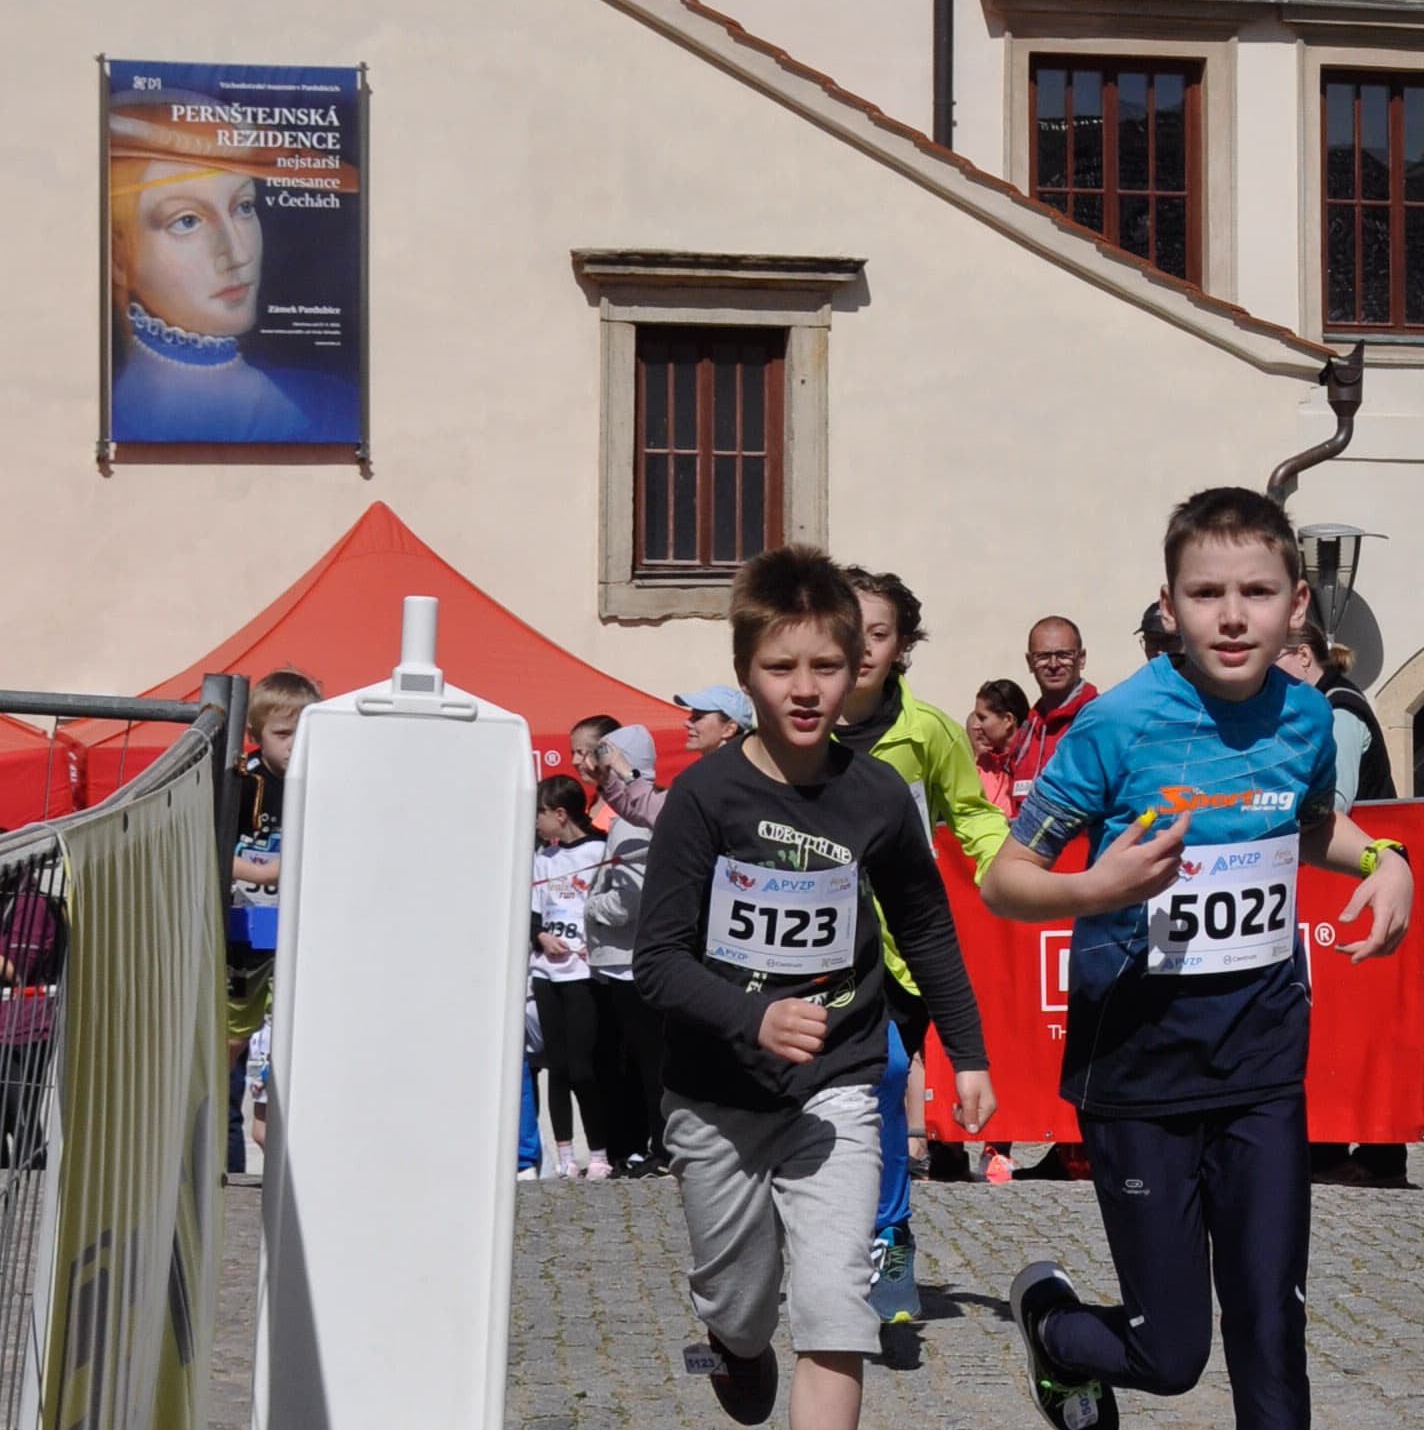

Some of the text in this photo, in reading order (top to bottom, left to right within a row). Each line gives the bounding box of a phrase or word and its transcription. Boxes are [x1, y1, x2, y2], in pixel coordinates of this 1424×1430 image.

[172, 103, 339, 126] PERNŠTEJNSKÁ
[217, 129, 340, 149] REZIDENCE
[277, 155, 340, 171] nejstarší
[267, 176, 340, 188] renesance
[266, 191, 340, 208] v Čechách
[1159, 786, 1295, 813] Sporting
[1229, 852, 1261, 866] PVZP
[781, 879, 815, 891] PVZP
[1168, 883, 1287, 943] 5022
[728, 899, 838, 948] 5123
